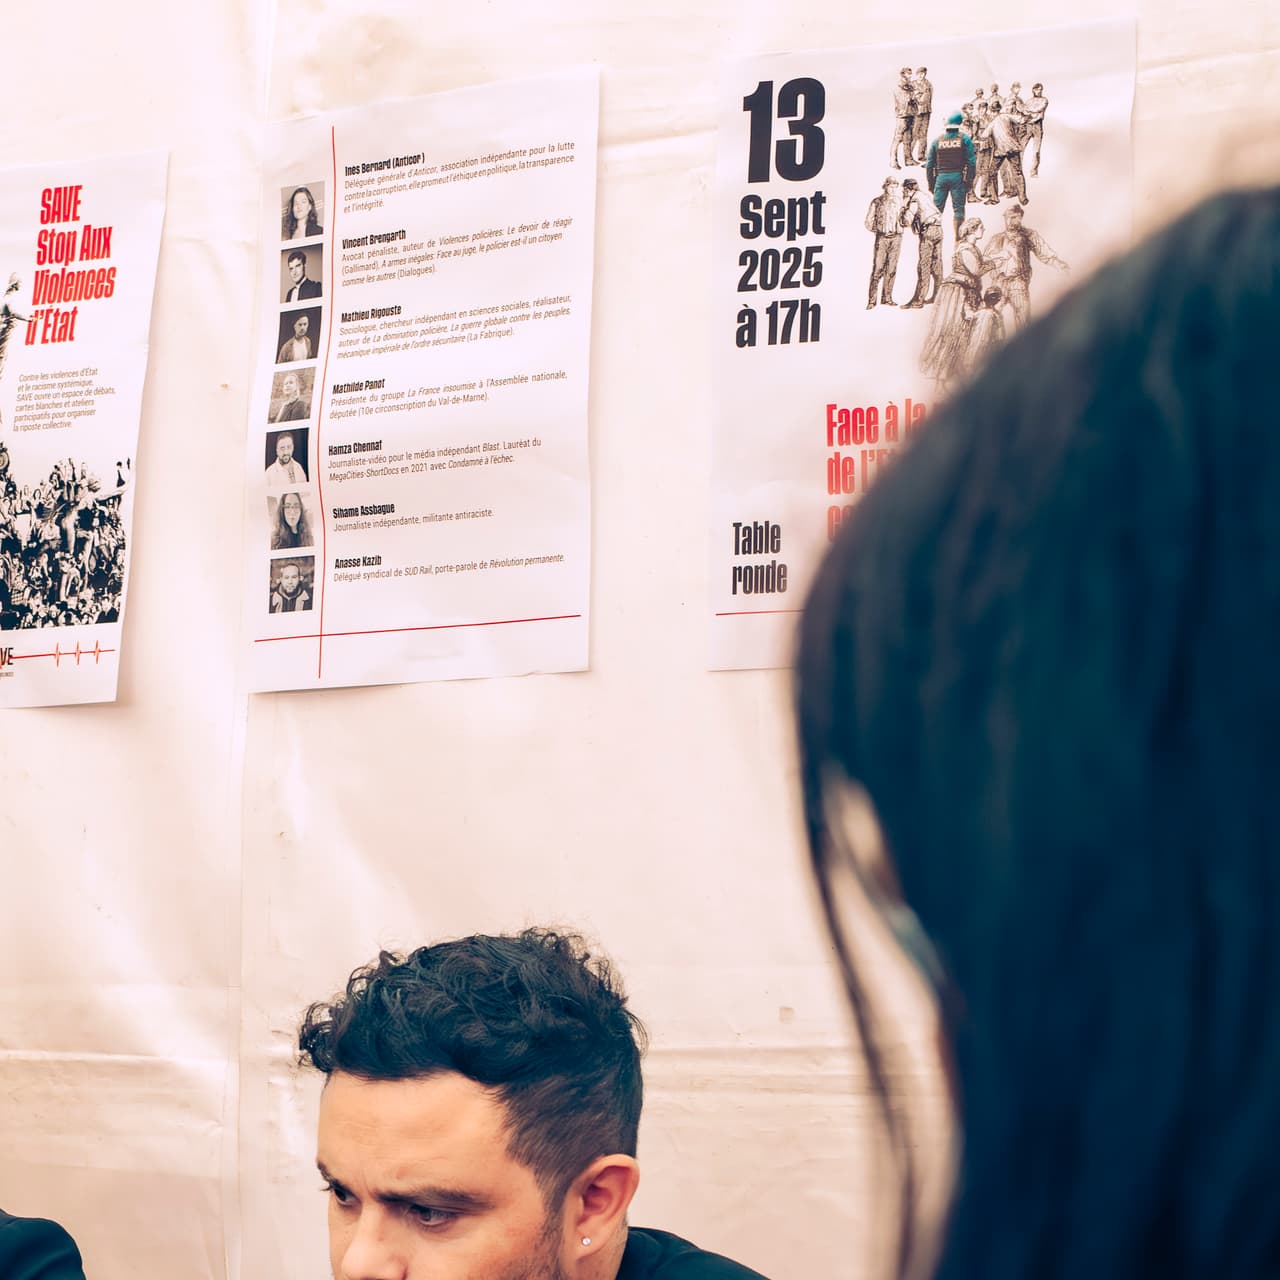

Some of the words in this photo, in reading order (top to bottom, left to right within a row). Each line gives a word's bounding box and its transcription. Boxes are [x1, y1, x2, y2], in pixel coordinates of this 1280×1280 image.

[743, 77, 825, 183] 13
[938, 139, 961, 149] POLICE
[40, 185, 83, 225] SAVE
[740, 190, 826, 241] Sept
[36, 229, 78, 266] Stop
[79, 224, 112, 262] Aux
[31, 266, 116, 306] Violences
[737, 245, 823, 292] 2025
[736, 303, 757, 348] à
[765, 298, 821, 345] 17h
[16, 393, 33, 401] SAVE
[84, 388, 92, 396] de
[826, 404, 879, 447] Face
[885, 401, 898, 442] à
[827, 452, 855, 495] de
[733, 520, 781, 555] Table
[732, 560, 787, 595] ronde
